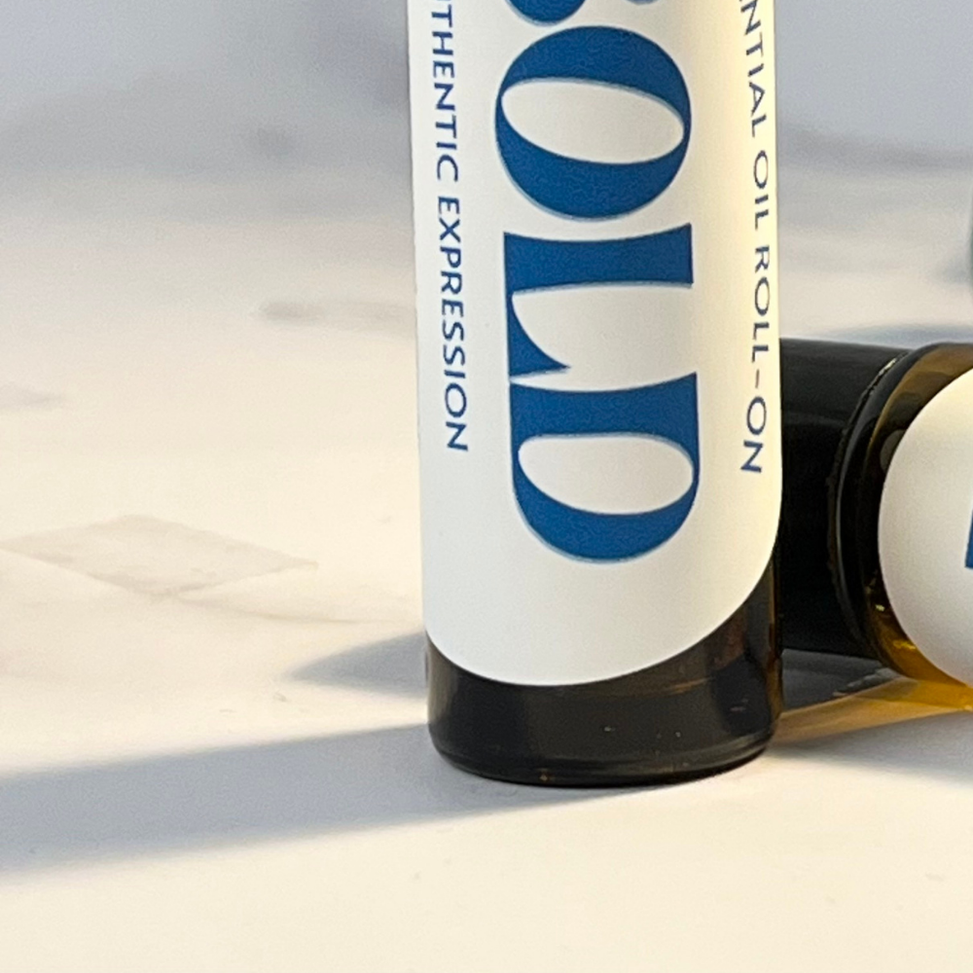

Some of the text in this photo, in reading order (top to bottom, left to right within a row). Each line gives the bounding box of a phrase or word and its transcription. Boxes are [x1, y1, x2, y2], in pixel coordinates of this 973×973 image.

[752, 149, 770, 231] OIL
[437, 195, 469, 452] EXPRESSION
[740, 243, 771, 474] ROLL-ON
